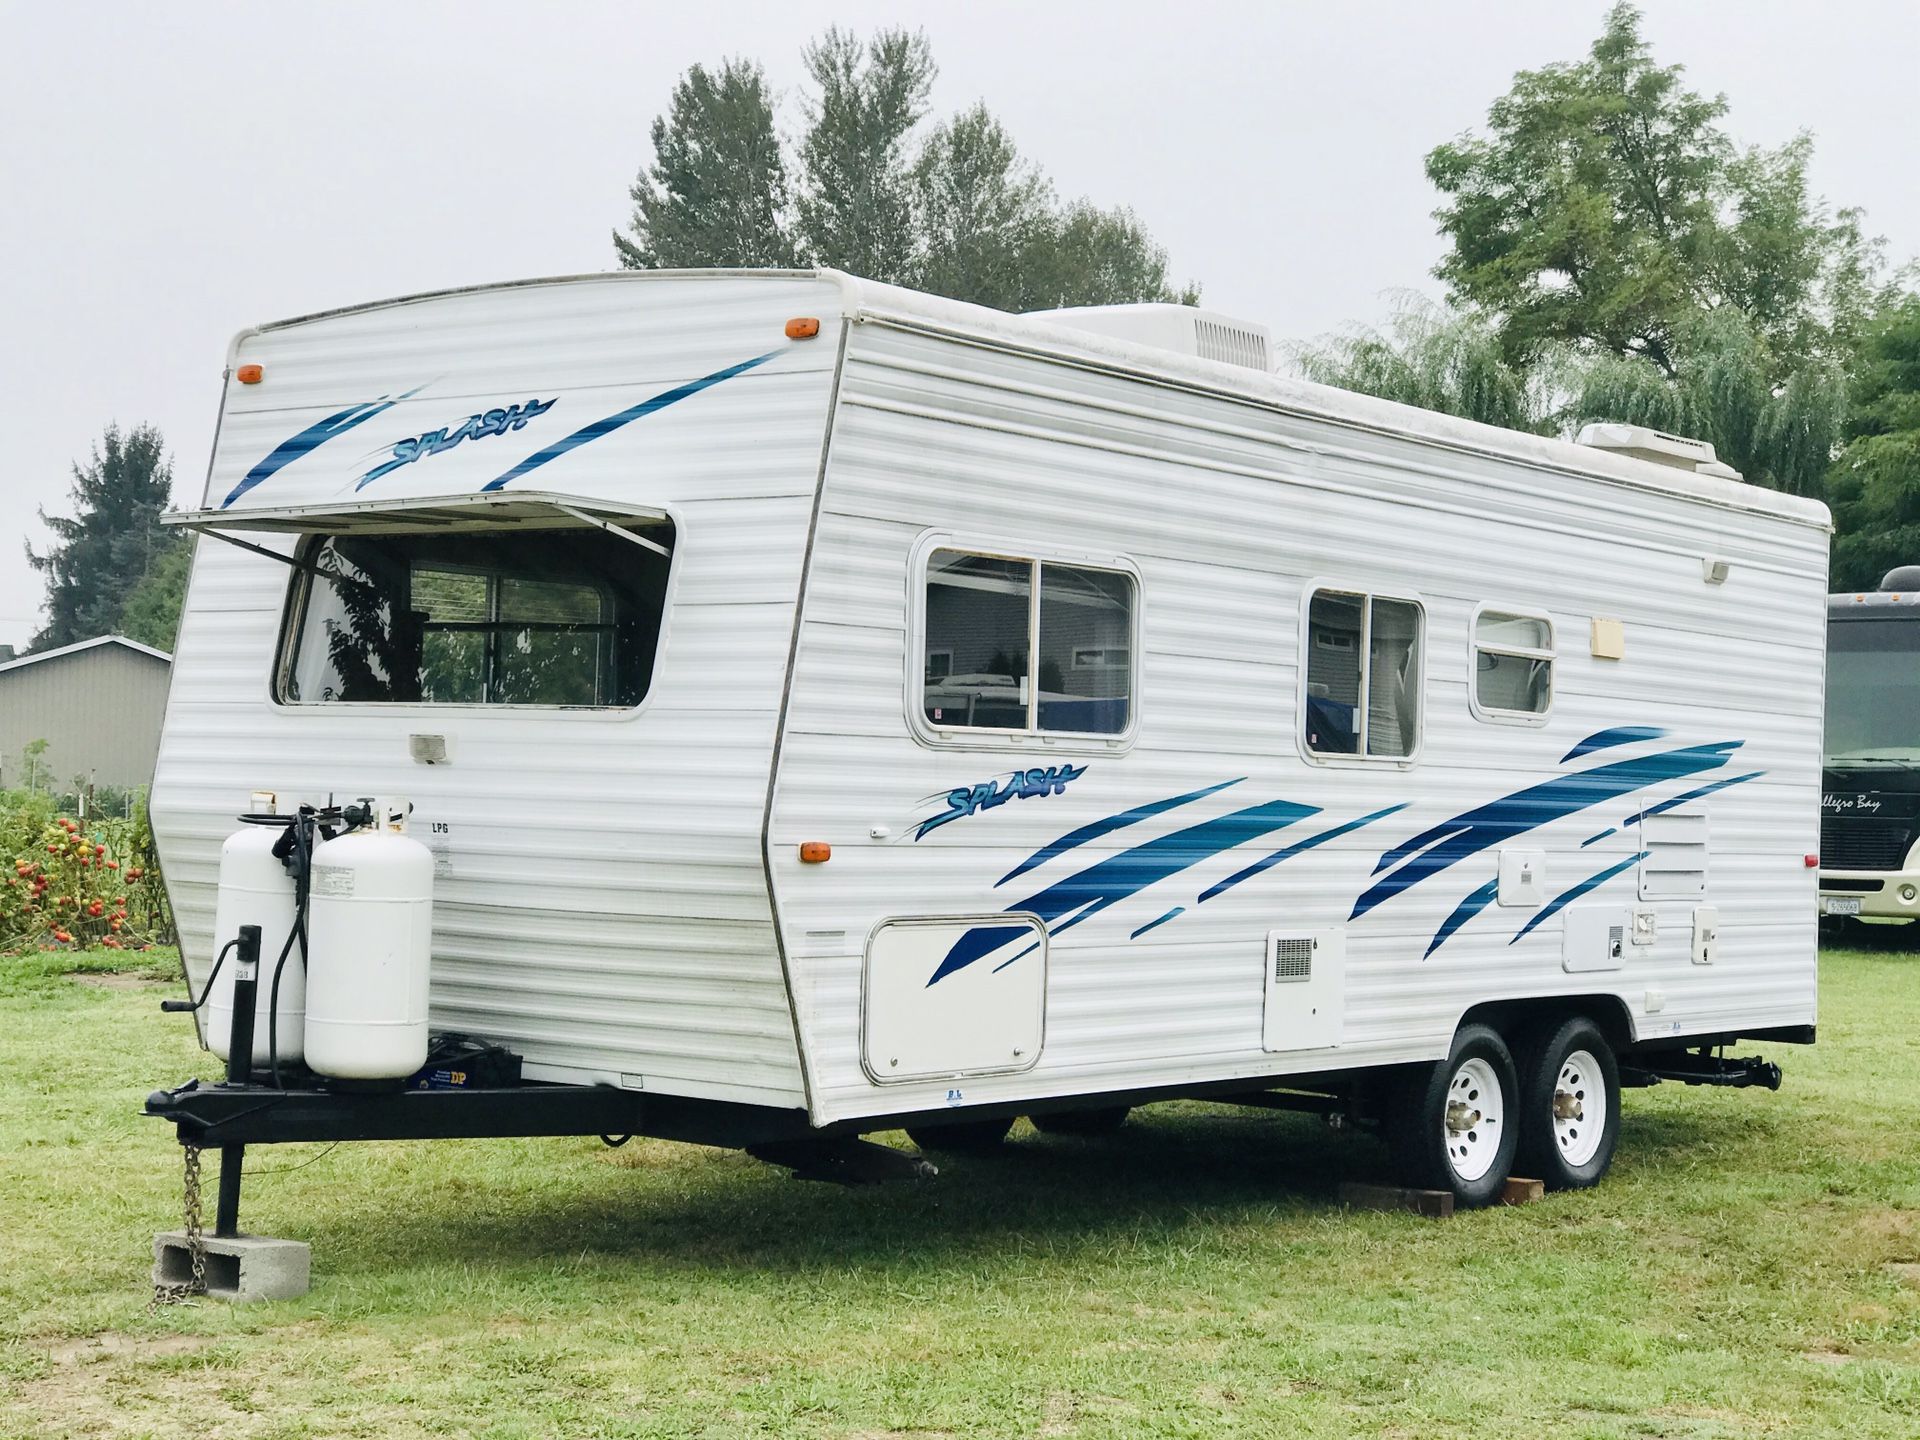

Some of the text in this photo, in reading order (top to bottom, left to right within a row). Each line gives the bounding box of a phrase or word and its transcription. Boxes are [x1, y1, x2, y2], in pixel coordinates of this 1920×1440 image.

[355, 397, 560, 493] SPLASH
[914, 763, 1090, 843] SPLASH
[1821, 794, 1881, 813] llegro Bay
[432, 822, 449, 833] LPG
[450, 1071, 467, 1085] DP
